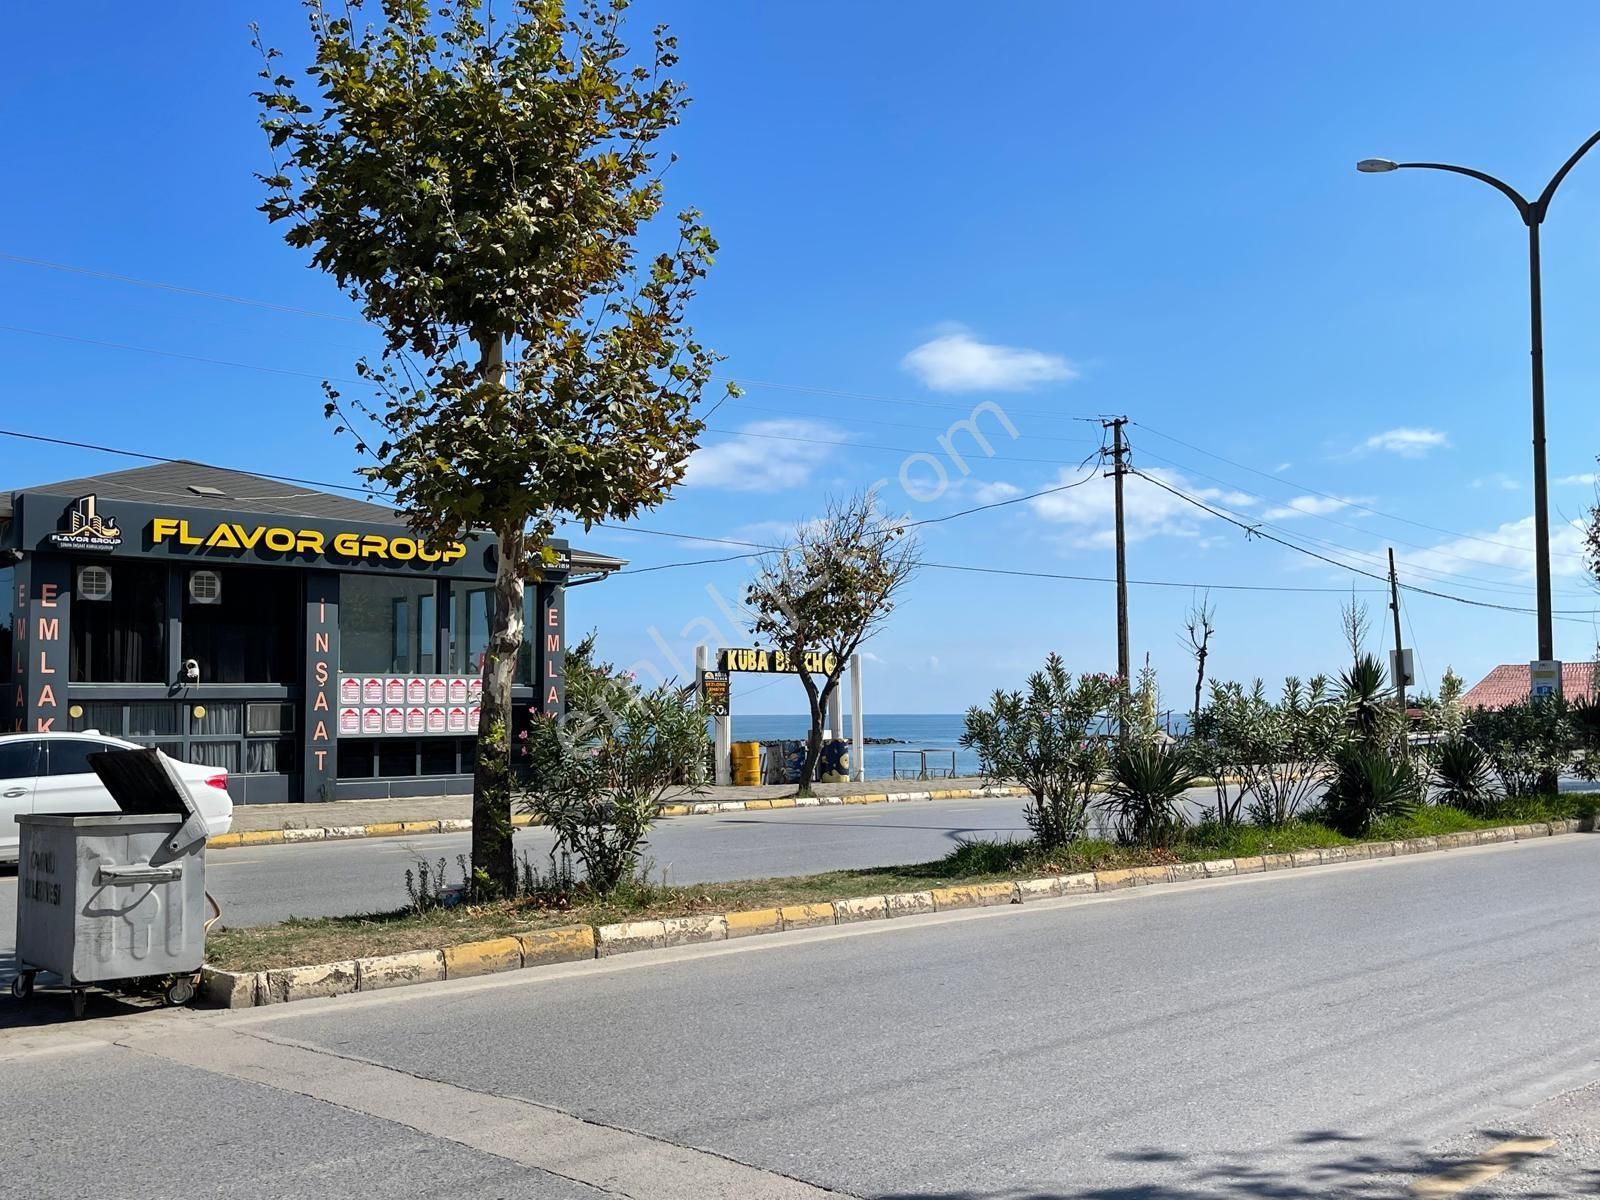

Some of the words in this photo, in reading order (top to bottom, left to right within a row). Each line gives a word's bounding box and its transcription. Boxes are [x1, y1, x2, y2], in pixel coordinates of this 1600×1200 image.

[51, 534, 89, 543] FLAVOR
[90, 537, 122, 545] GROUP
[152, 517, 325, 554] FLAVOR
[333, 533, 468, 563] GROUP
[15, 584, 26, 733] EMLAK
[37, 584, 59, 733] EMLAK
[313, 597, 329, 771] İNŞAAT
[727, 649, 769, 672] KÜBA
[775, 650, 823, 673] BECH
